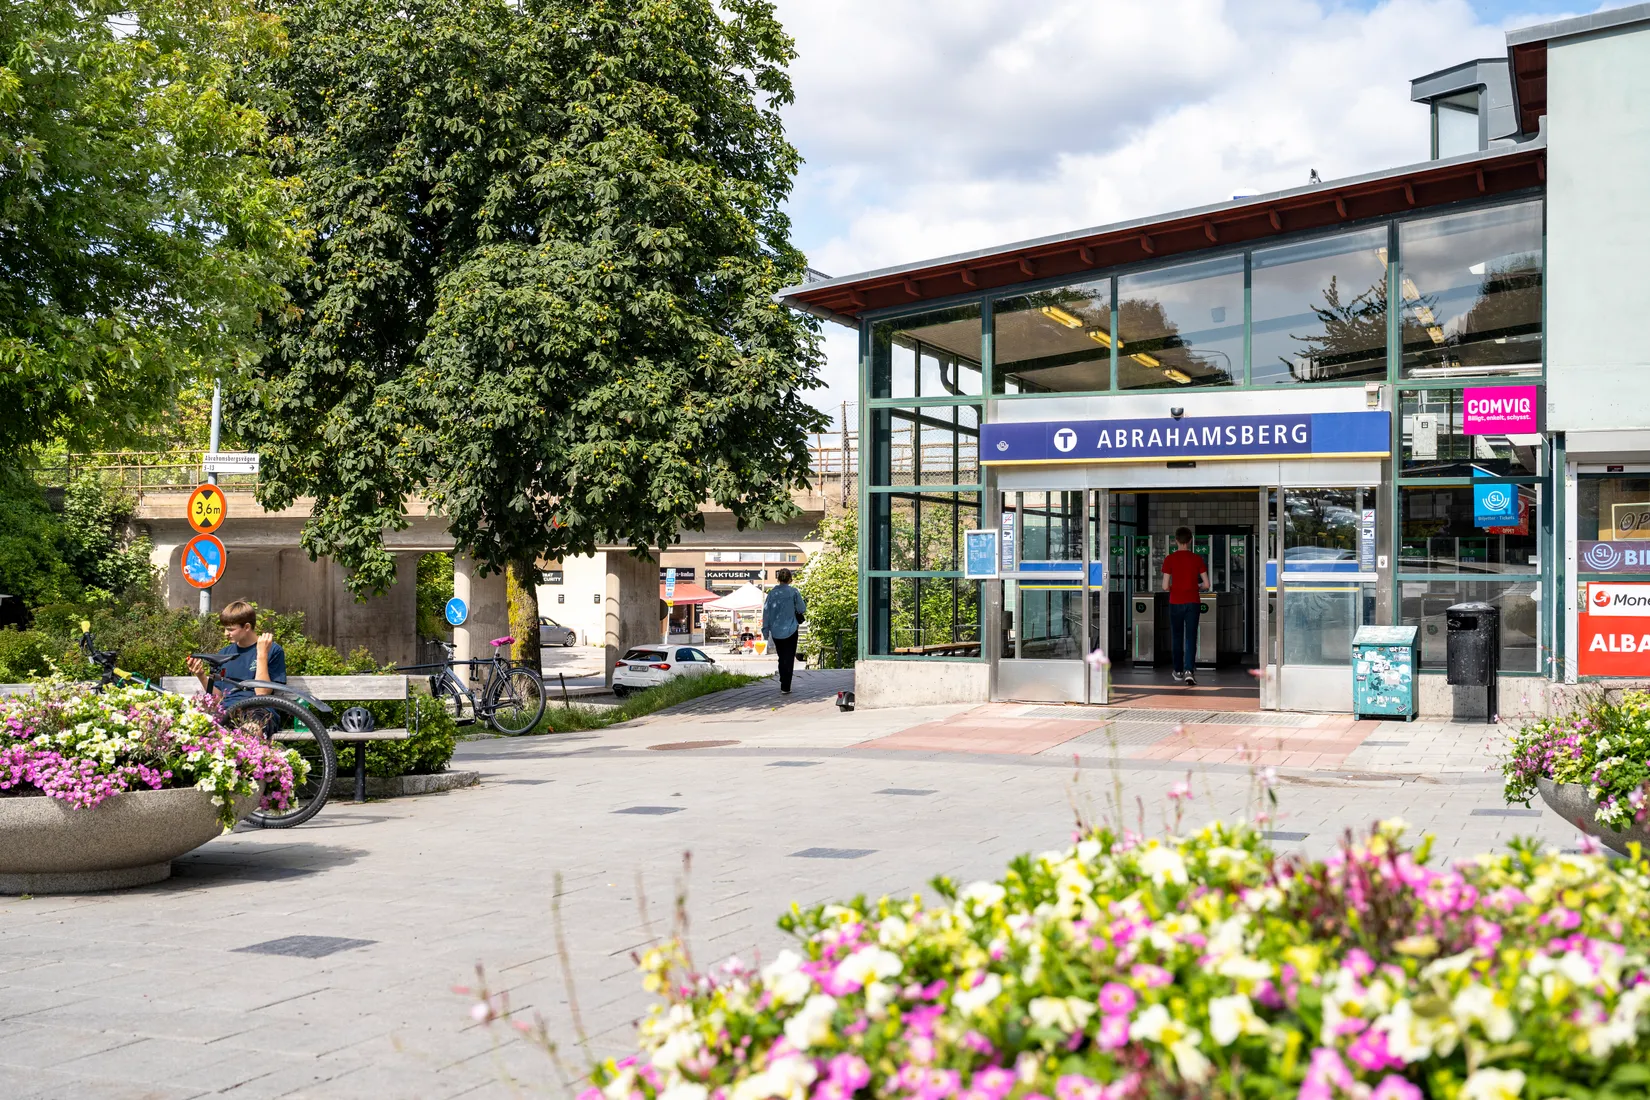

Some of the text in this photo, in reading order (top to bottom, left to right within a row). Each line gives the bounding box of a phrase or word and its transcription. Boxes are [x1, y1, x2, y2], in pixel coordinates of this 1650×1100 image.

[1468, 398, 1531, 414] COMVIQ
[1097, 424, 1307, 449] ABRAHAMSBERG
[204, 455, 256, 463] Abrahamsbergsvägen
[1490, 494, 1501, 502] SL
[1596, 548, 1609, 558] SL
